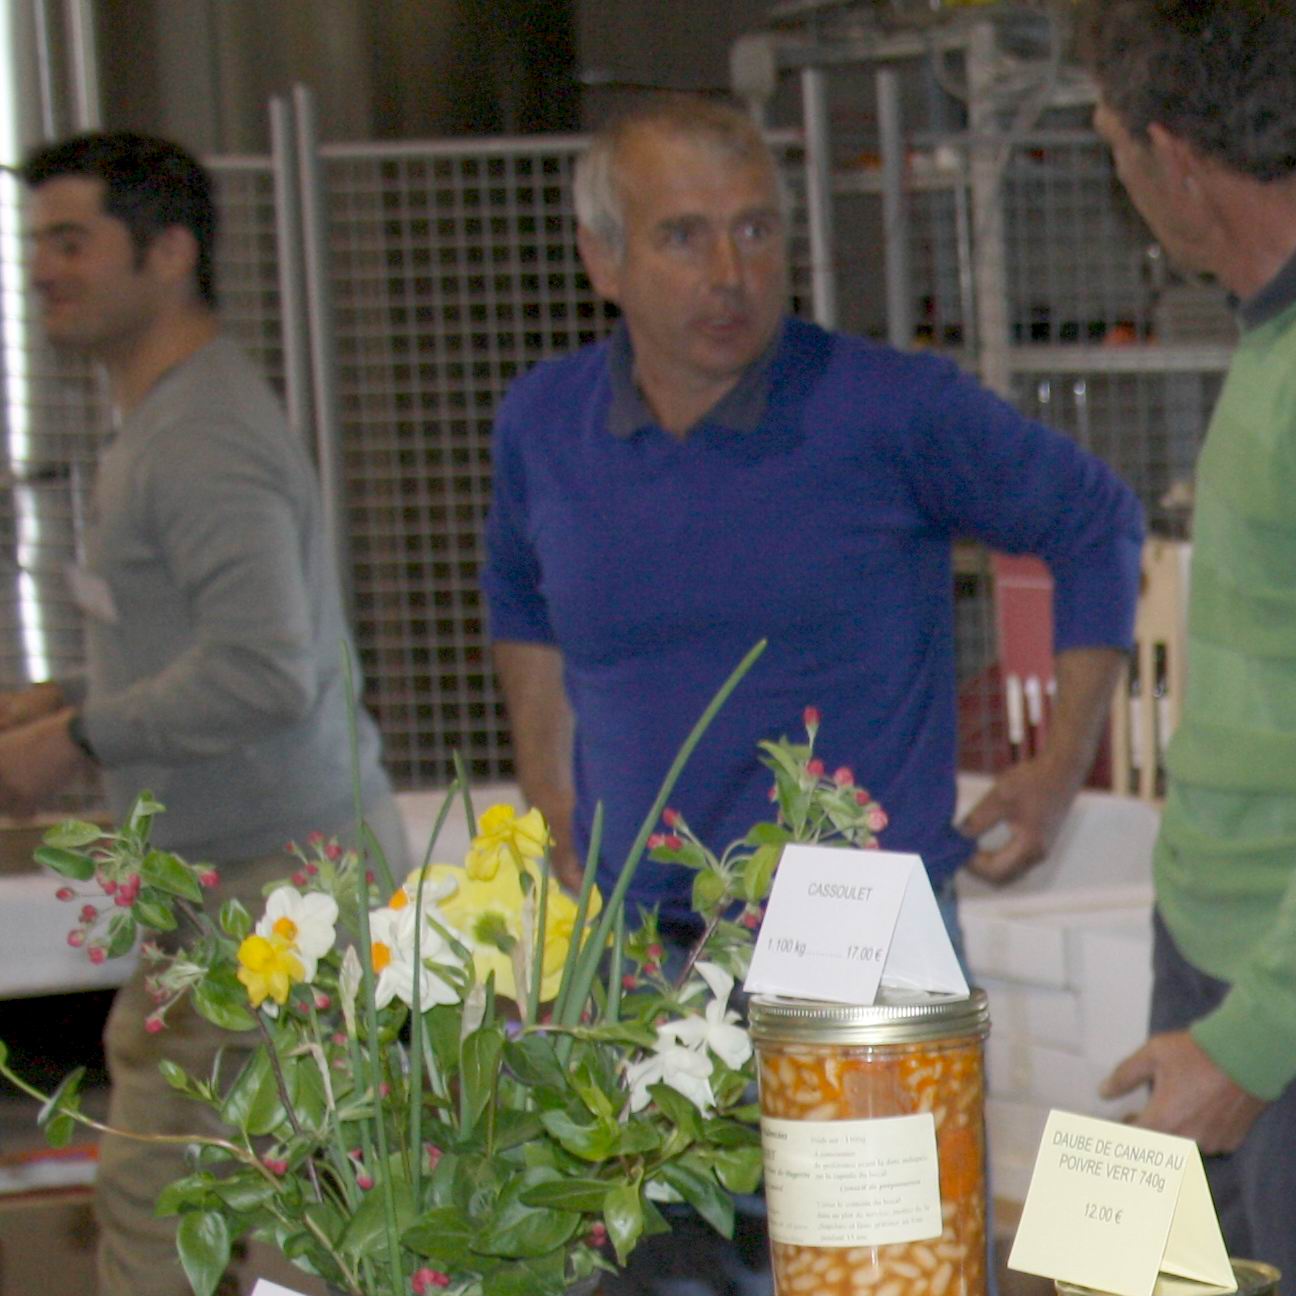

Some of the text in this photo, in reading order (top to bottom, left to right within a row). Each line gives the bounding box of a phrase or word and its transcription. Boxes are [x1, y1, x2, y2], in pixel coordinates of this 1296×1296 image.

[808, 882, 873, 901] CASSOULET
[874, 948, 884, 963] €
[1052, 1131, 1184, 1171] DAUBE DE CANARD AU
[1059, 1154, 1102, 1176] POIVRE
[1106, 1164, 1137, 1183] VERT
[1084, 1202, 1124, 1224] 12.00 €
